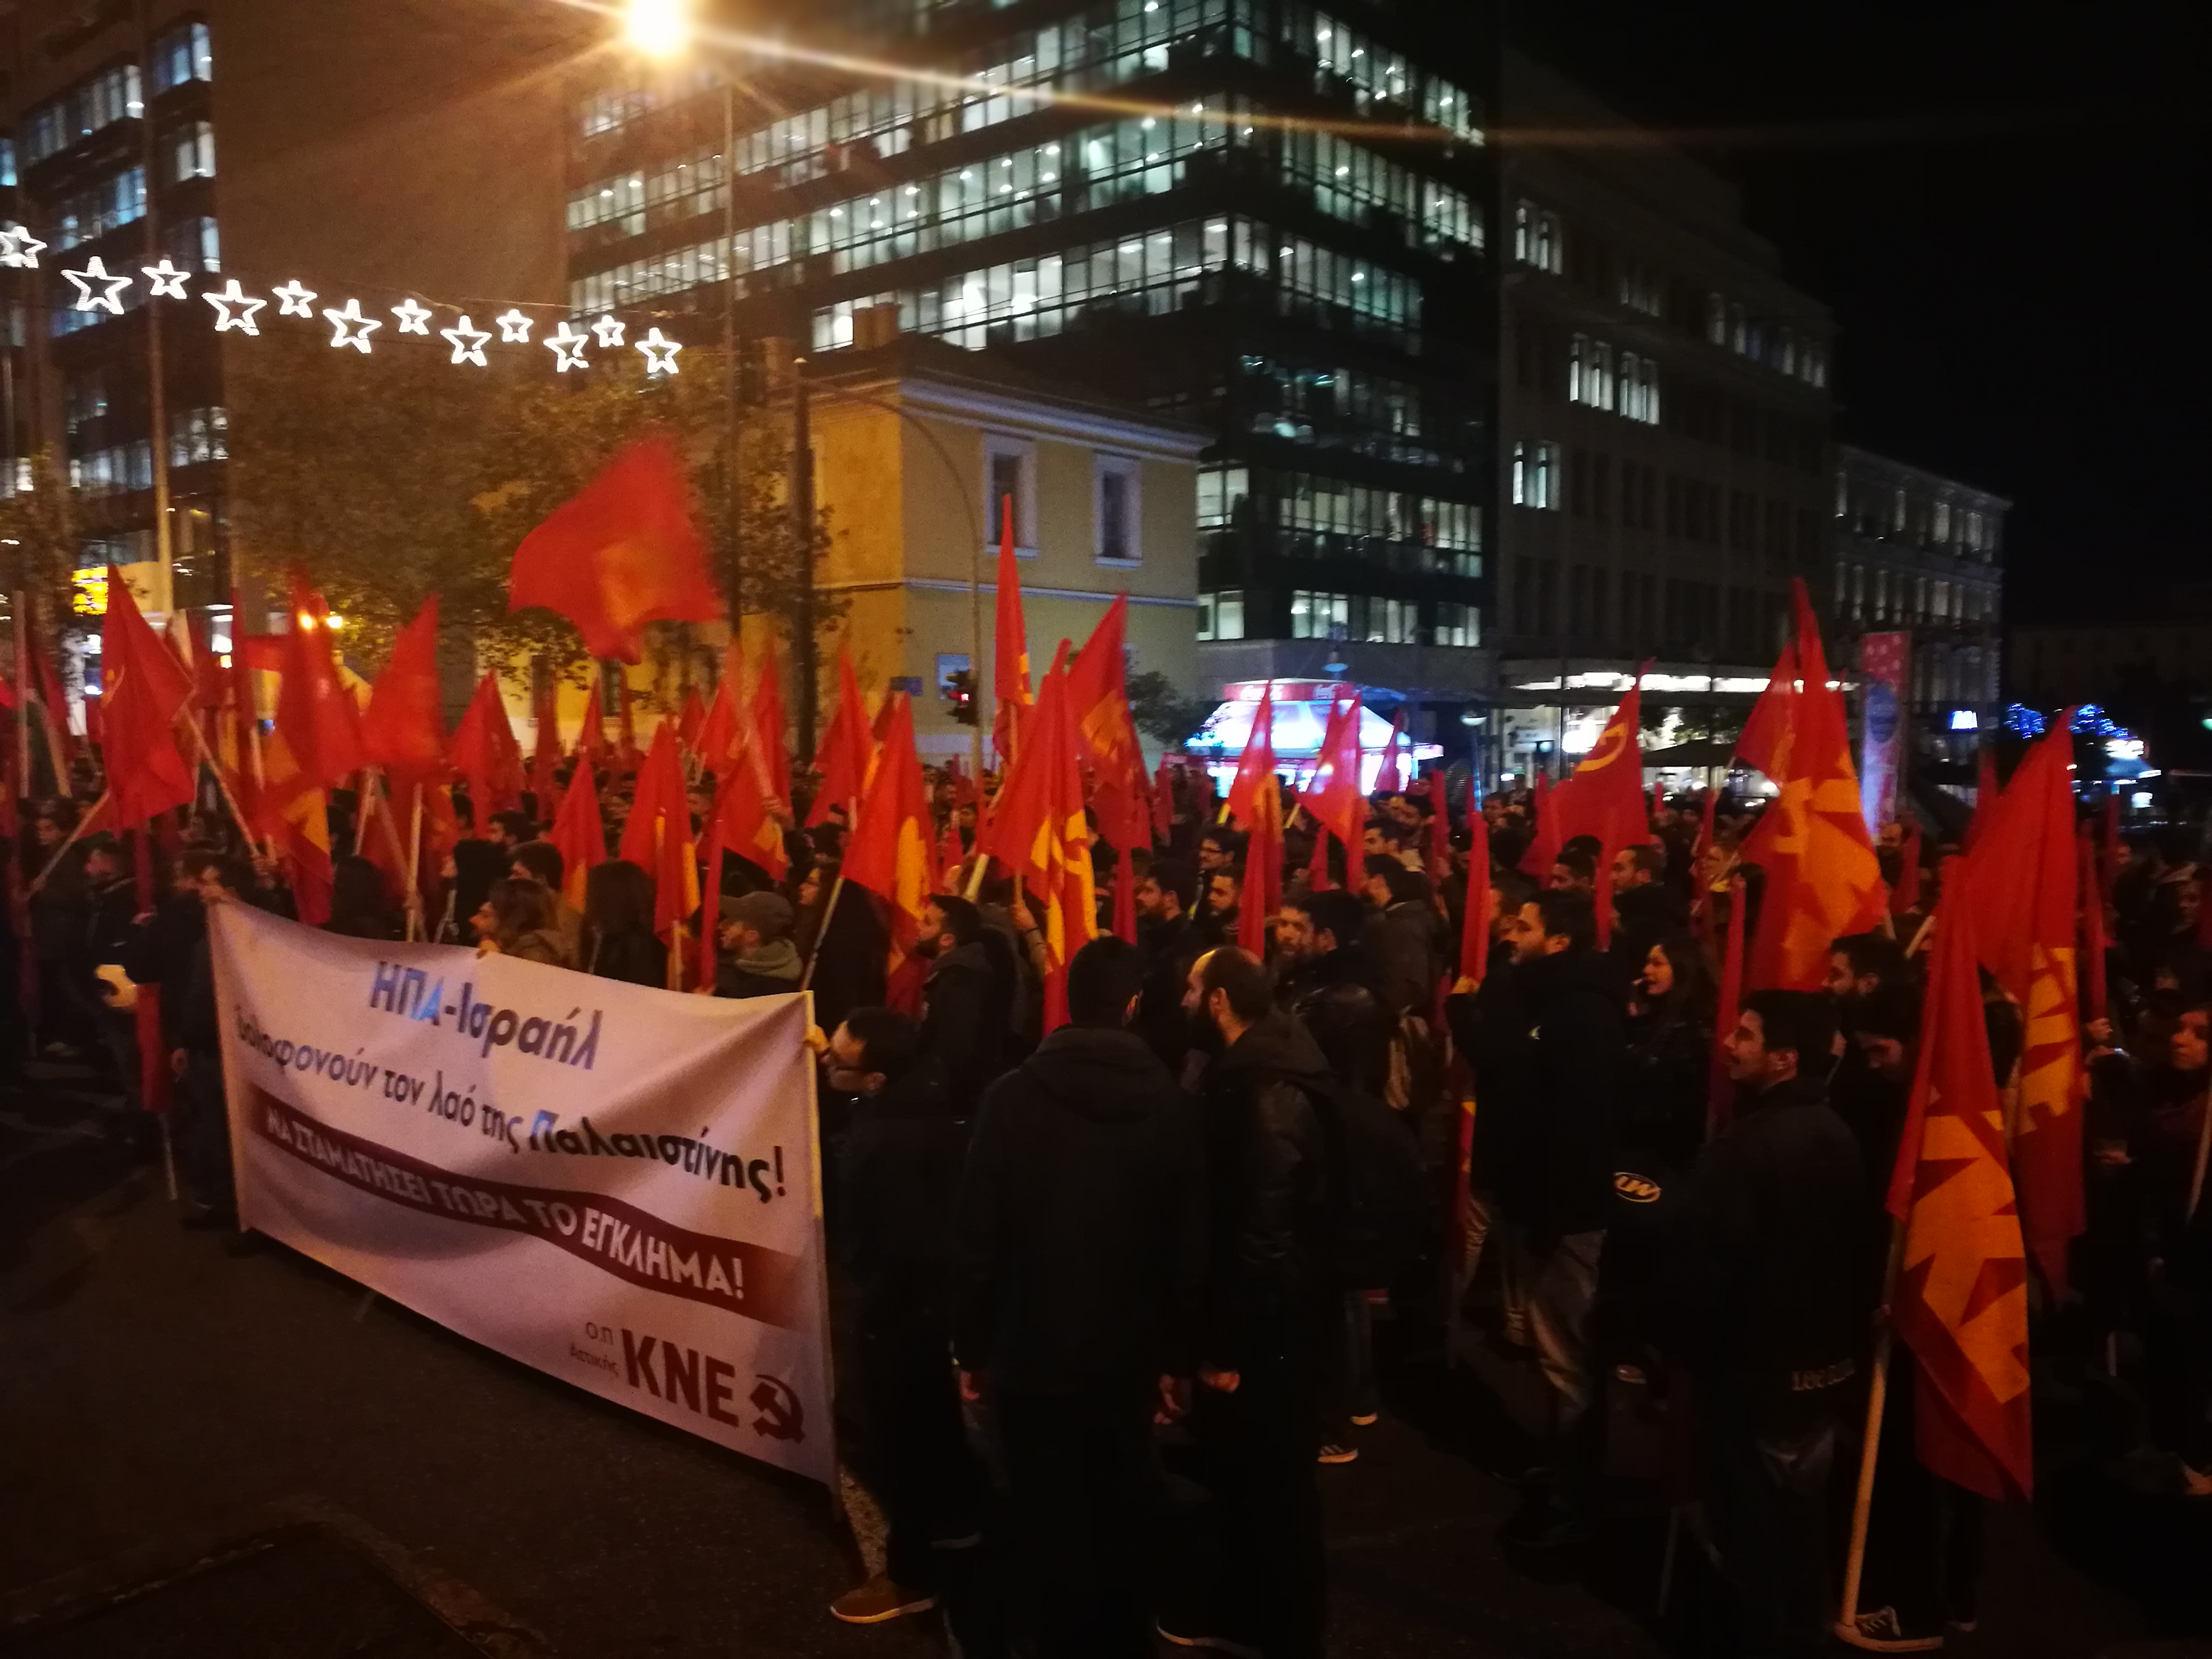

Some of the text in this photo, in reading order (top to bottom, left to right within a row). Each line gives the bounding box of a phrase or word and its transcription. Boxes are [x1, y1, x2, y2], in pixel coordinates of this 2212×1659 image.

[369, 961, 603, 1070] ΗΠΑ-Ισραήλ
[384, 1070, 425, 1105] τον
[428, 1070, 477, 1126] λαό
[482, 1104, 523, 1154] της
[531, 1110, 785, 1204] Παλαιστίνης!
[431, 1181, 529, 1225] ΤΩΡΑ
[525, 1199, 578, 1236] ΤΟ
[581, 1207, 744, 1300] ΕΓΚΛΗΜΑ!
[621, 1328, 739, 1428] ΚΝΕ
